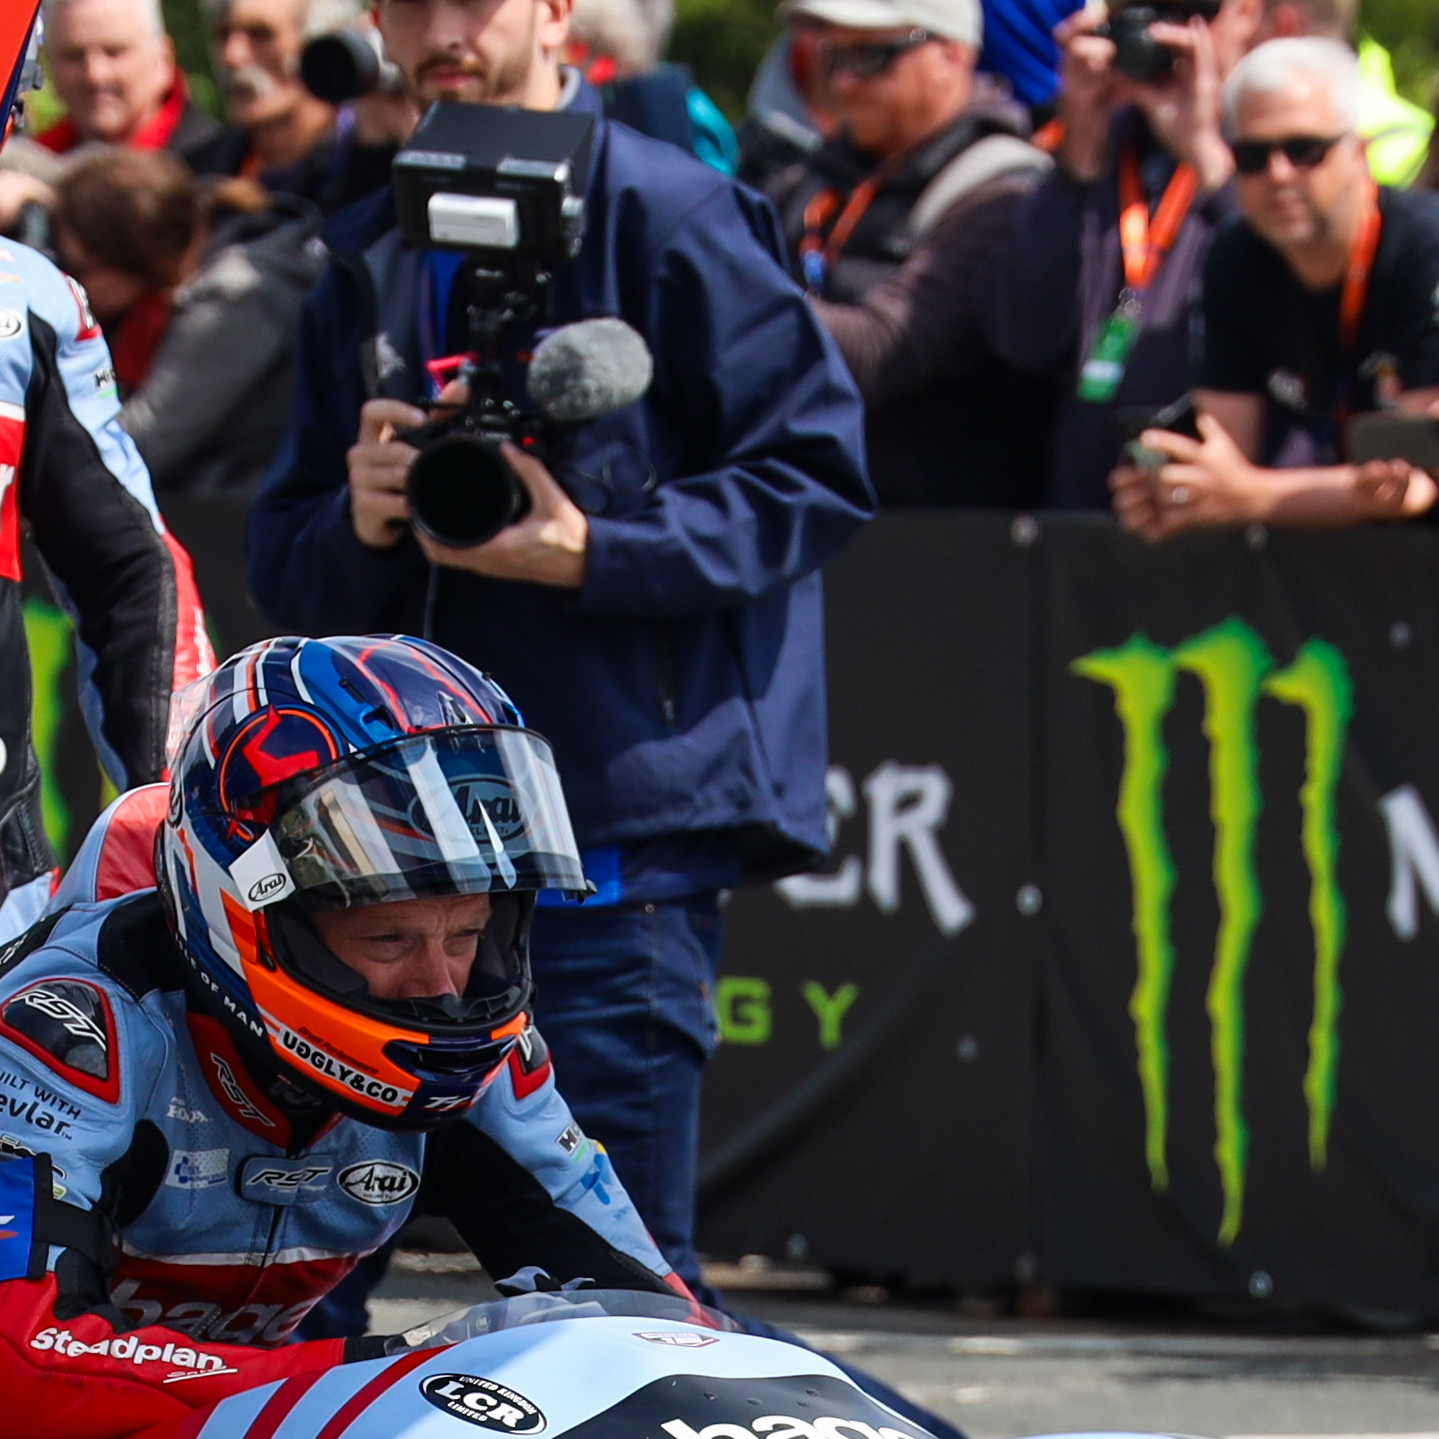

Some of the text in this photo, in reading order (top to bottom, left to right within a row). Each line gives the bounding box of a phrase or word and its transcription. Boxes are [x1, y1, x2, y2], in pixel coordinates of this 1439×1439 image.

[223, 995, 264, 1037] MAN
[33, 1085, 82, 1120] WITH
[245, 1166, 334, 1188] RST
[343, 1165, 410, 1193] Arai
[30, 1327, 227, 1370] Steadplan
[434, 1380, 525, 1428] LCR
[447, 1401, 488, 1422] LIMITED
